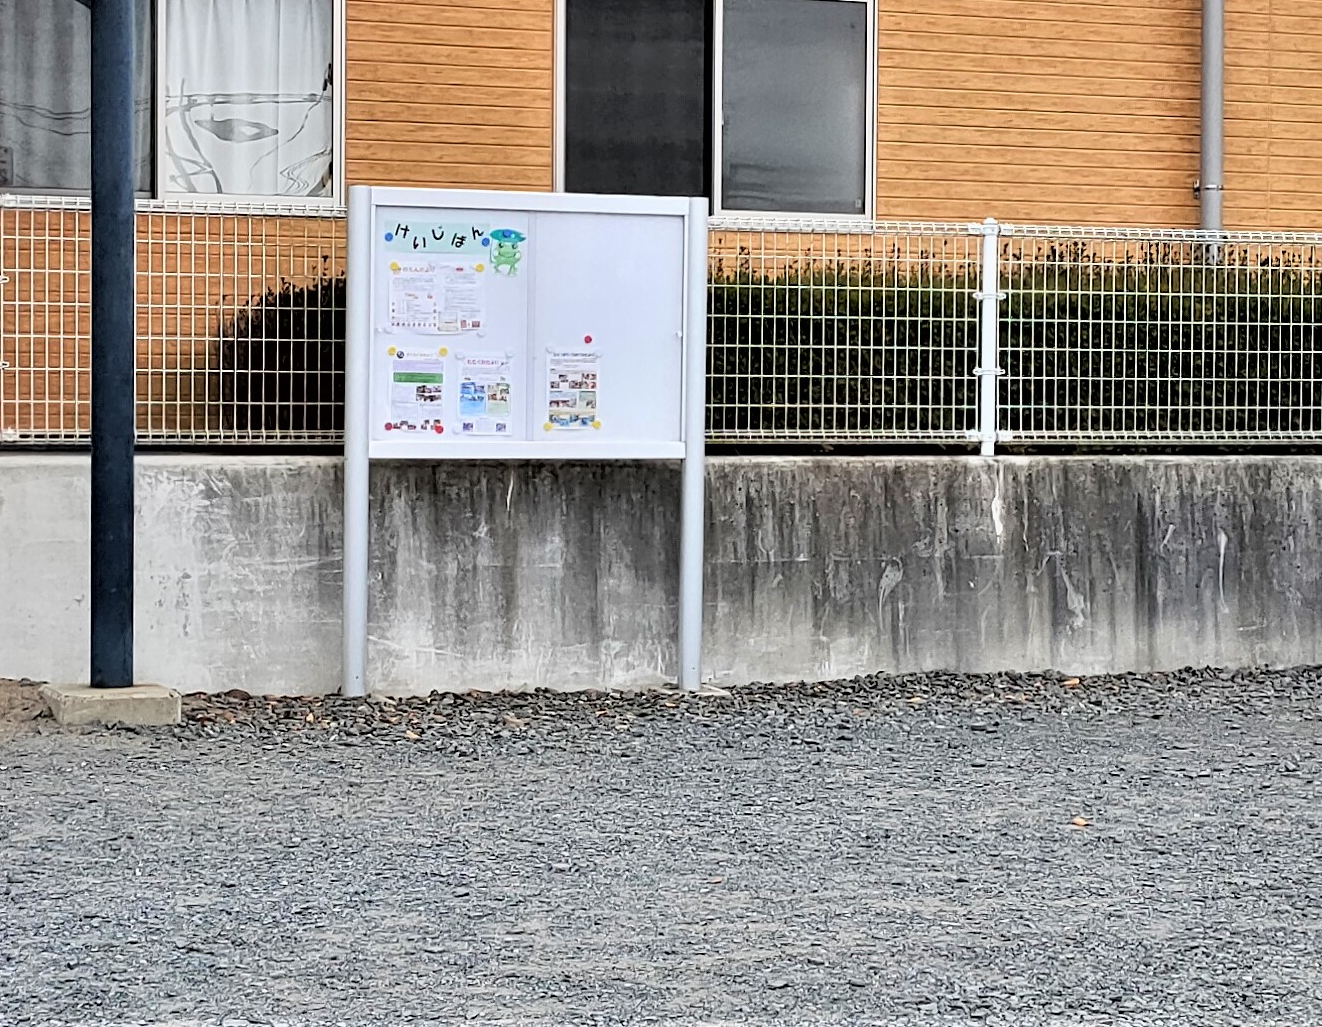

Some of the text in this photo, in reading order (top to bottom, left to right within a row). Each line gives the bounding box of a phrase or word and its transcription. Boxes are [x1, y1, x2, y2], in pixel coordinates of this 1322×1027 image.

[394, 223, 484, 249] けいじばん
